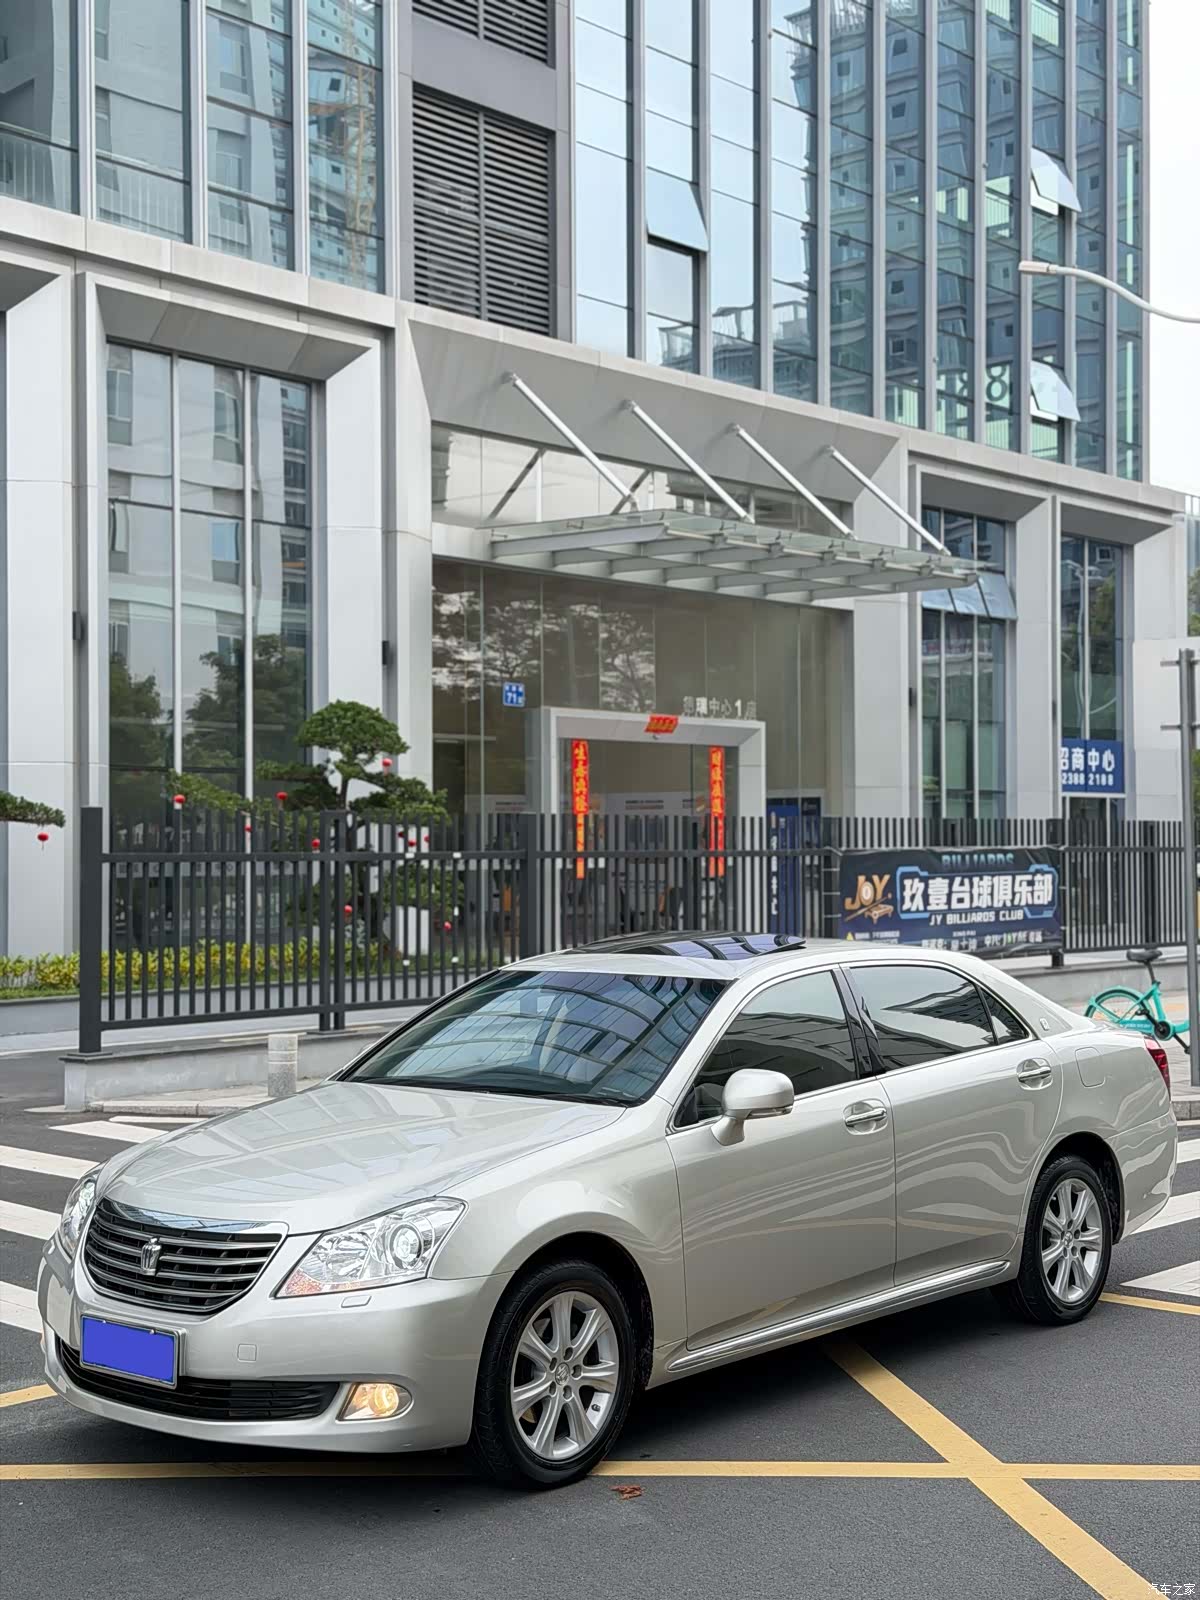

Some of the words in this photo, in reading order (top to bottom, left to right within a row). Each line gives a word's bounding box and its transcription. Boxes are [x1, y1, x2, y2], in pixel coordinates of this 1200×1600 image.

[902, 873, 1053, 911] 玖壹台球俱乐部
[929, 914, 942, 926] JY
[946, 911, 996, 925] BILLIARDS
[999, 909, 1024, 922] CLUB
